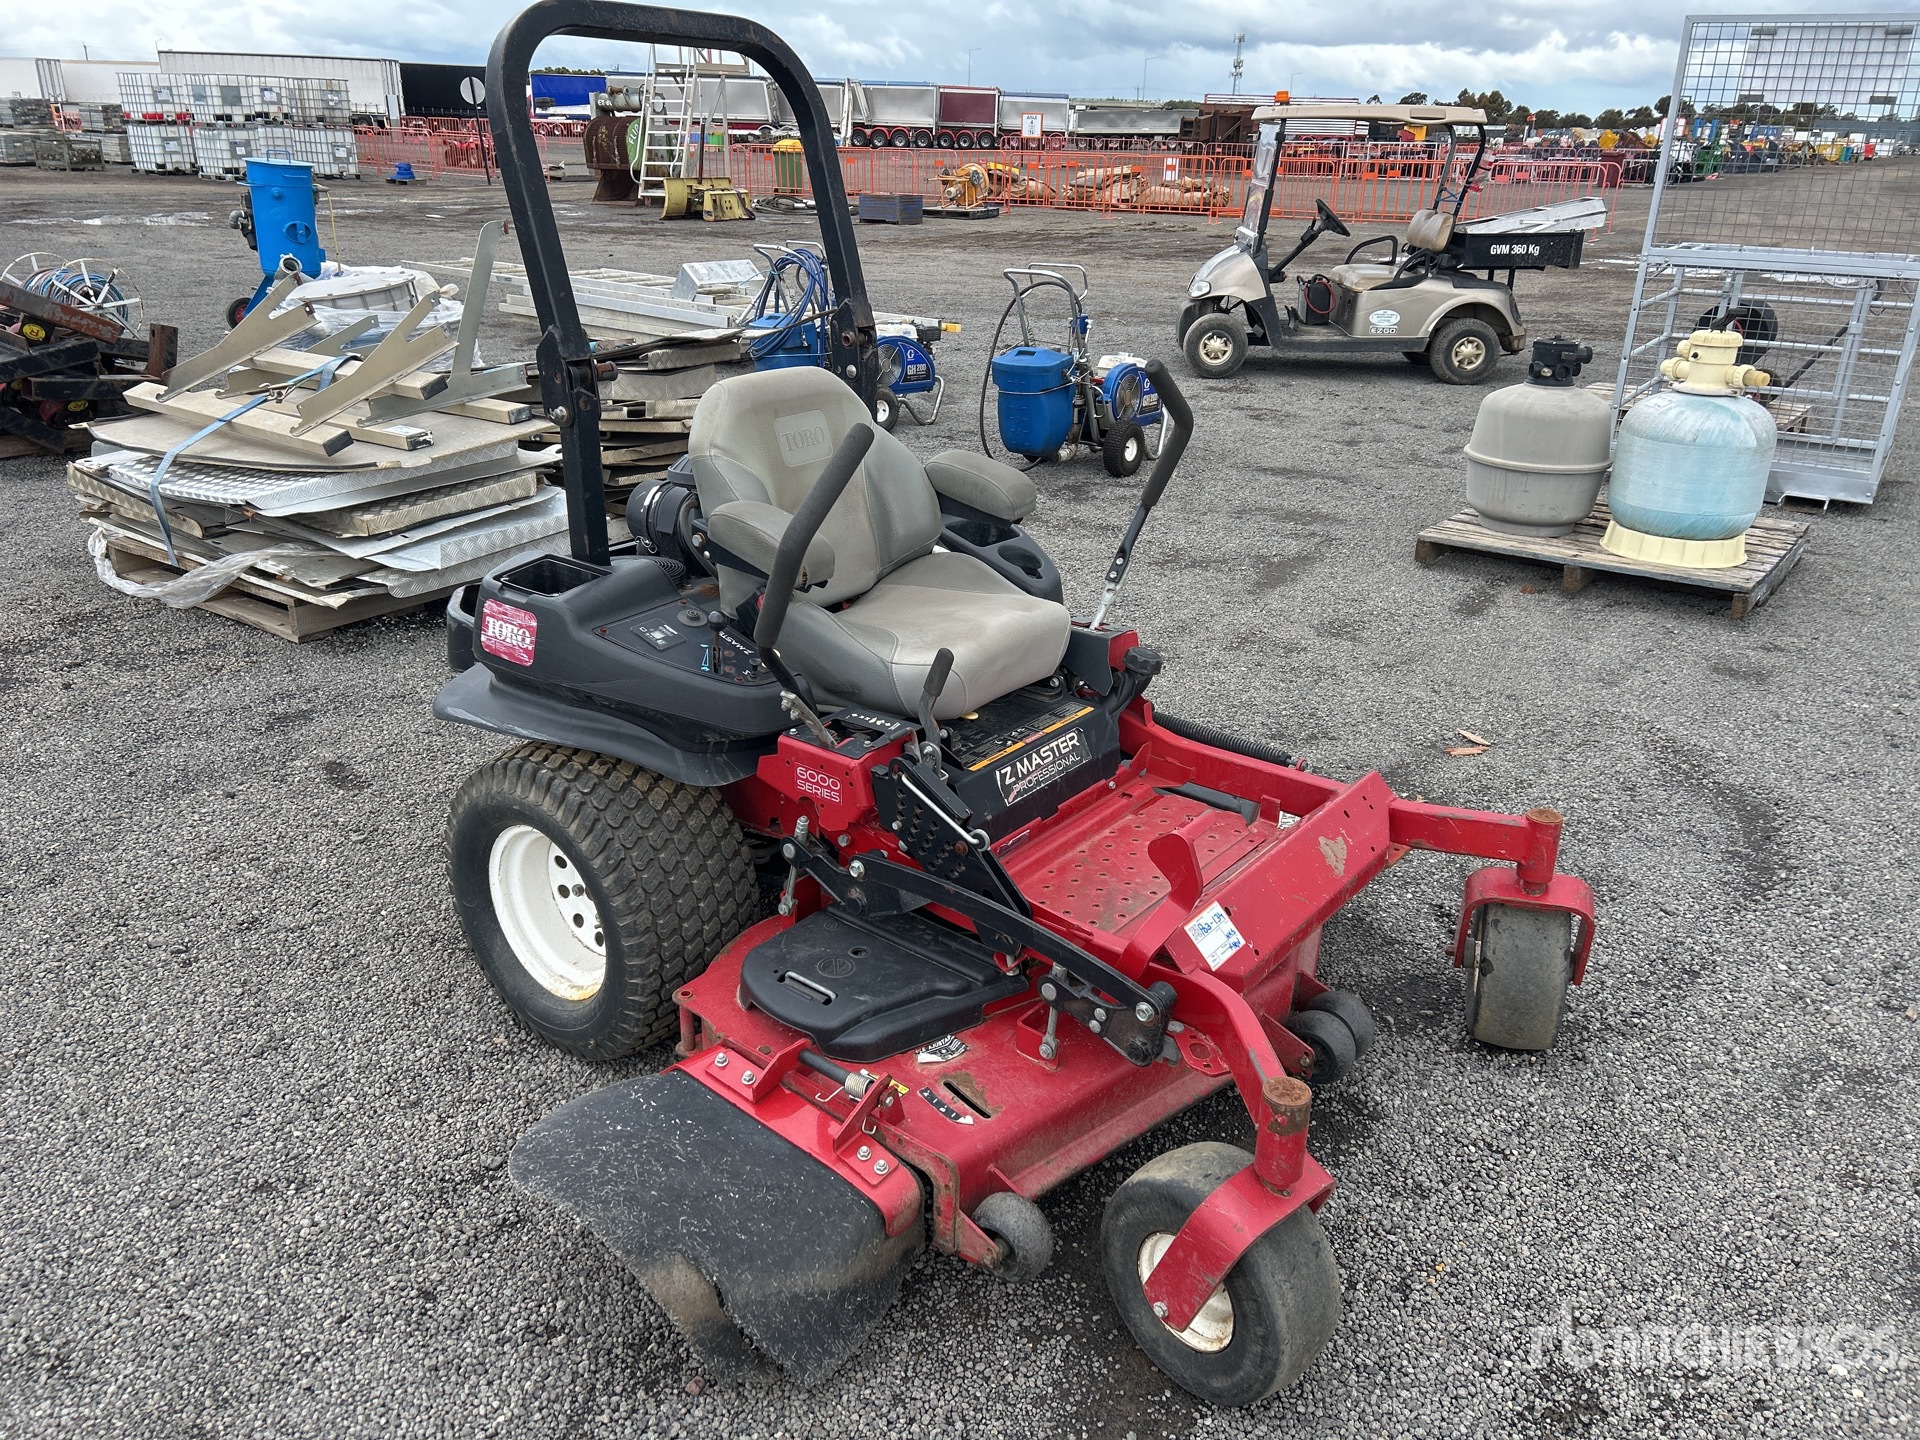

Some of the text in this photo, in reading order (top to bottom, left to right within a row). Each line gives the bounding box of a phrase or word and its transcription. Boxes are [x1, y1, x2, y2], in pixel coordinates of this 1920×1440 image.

[1490, 244, 1540, 256] GVM 360 Kg
[907, 363, 927, 376] GH 200
[779, 425, 825, 451] TORO
[1001, 766, 1016, 785] Z
[1016, 732, 1080, 777] MASTER
[796, 767, 841, 790] 6000
[1012, 752, 1081, 793] PROFESSIONAL
[796, 779, 840, 803] SERIES
